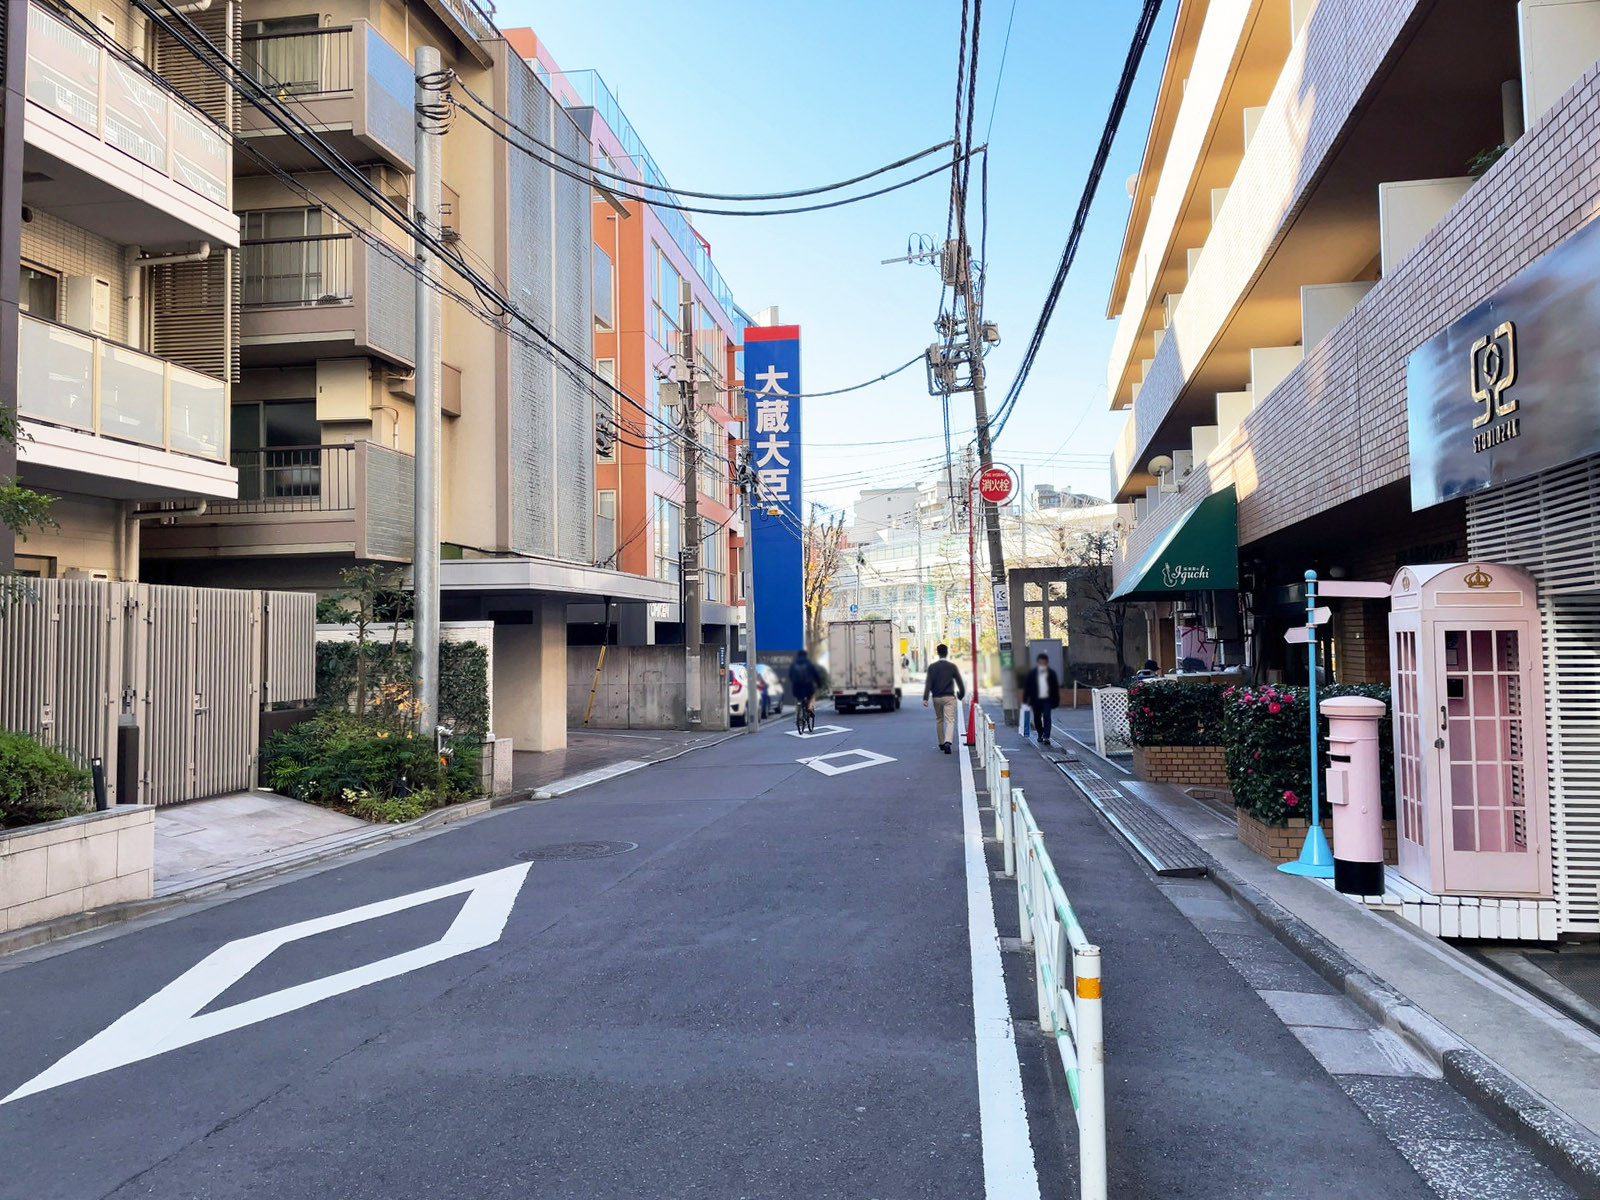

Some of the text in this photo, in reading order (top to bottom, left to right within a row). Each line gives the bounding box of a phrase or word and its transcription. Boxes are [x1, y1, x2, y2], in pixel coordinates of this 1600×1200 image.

[755, 365, 791, 502] 大蔵大臣
[1472, 418, 1519, 454] STUDIO24K
[981, 478, 1010, 492] 消火栓
[1171, 565, 1210, 585] Iguchi
